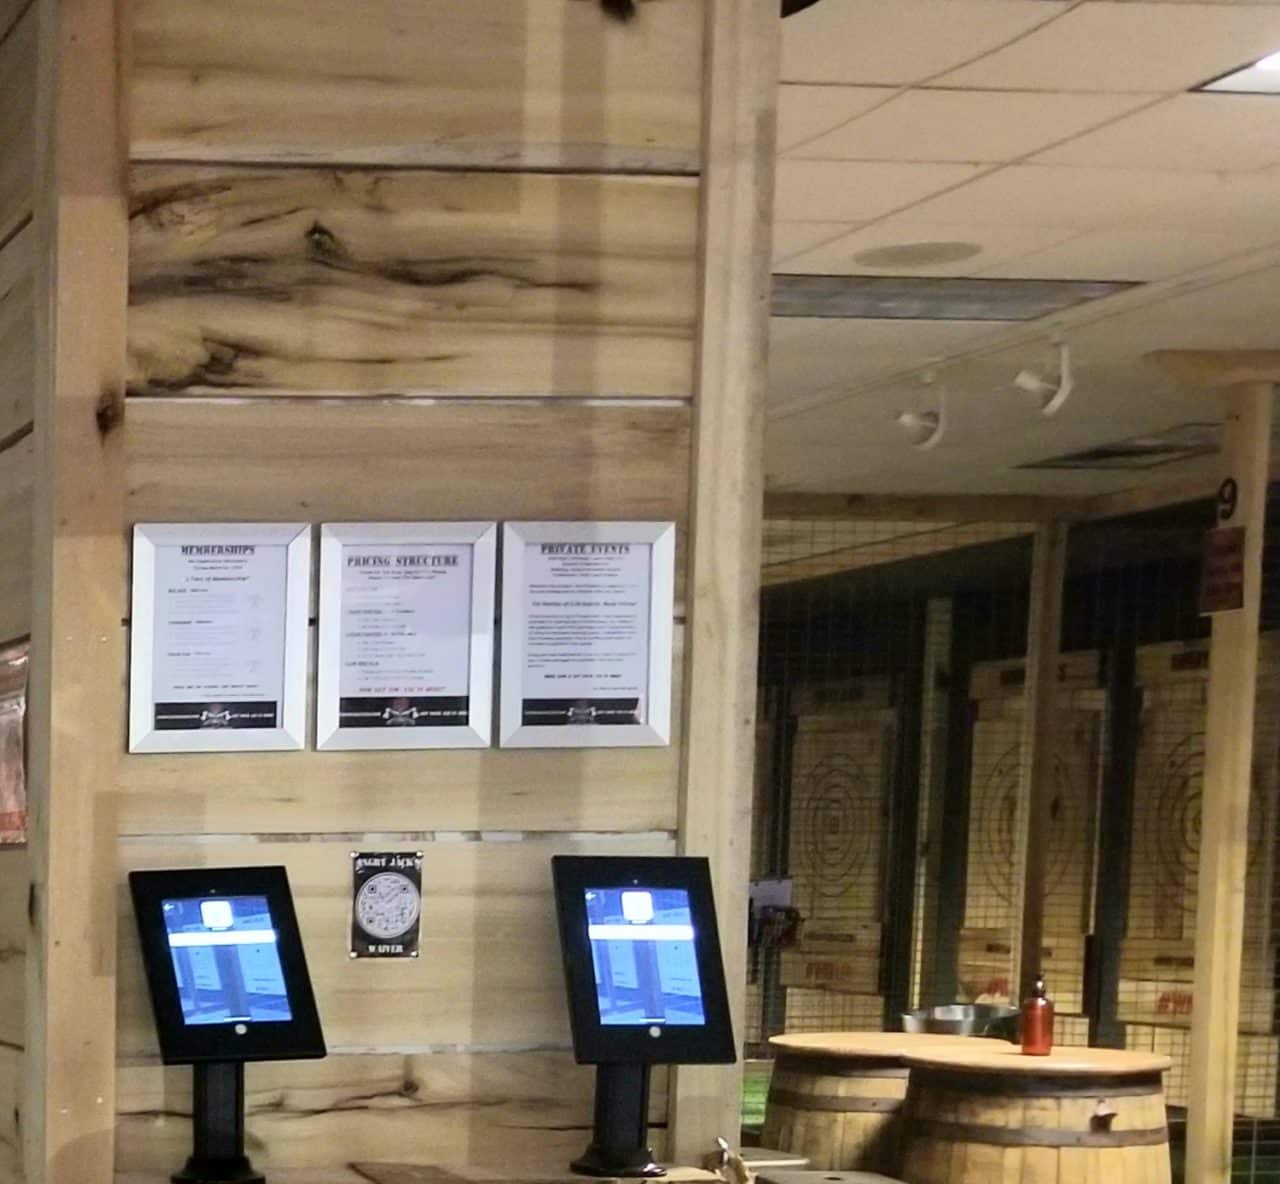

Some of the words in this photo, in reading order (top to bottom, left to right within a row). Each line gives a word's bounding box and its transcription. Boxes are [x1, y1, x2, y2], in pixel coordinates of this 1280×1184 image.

[1219, 477, 1238, 520] 9
[181, 545, 256, 555] MEMBERSHIPS
[540, 544, 588, 554] PRIVATE
[592, 544, 631, 554] EVENTS
[347, 556, 390, 567] PRICING
[396, 555, 459, 567] STRUCTURE
